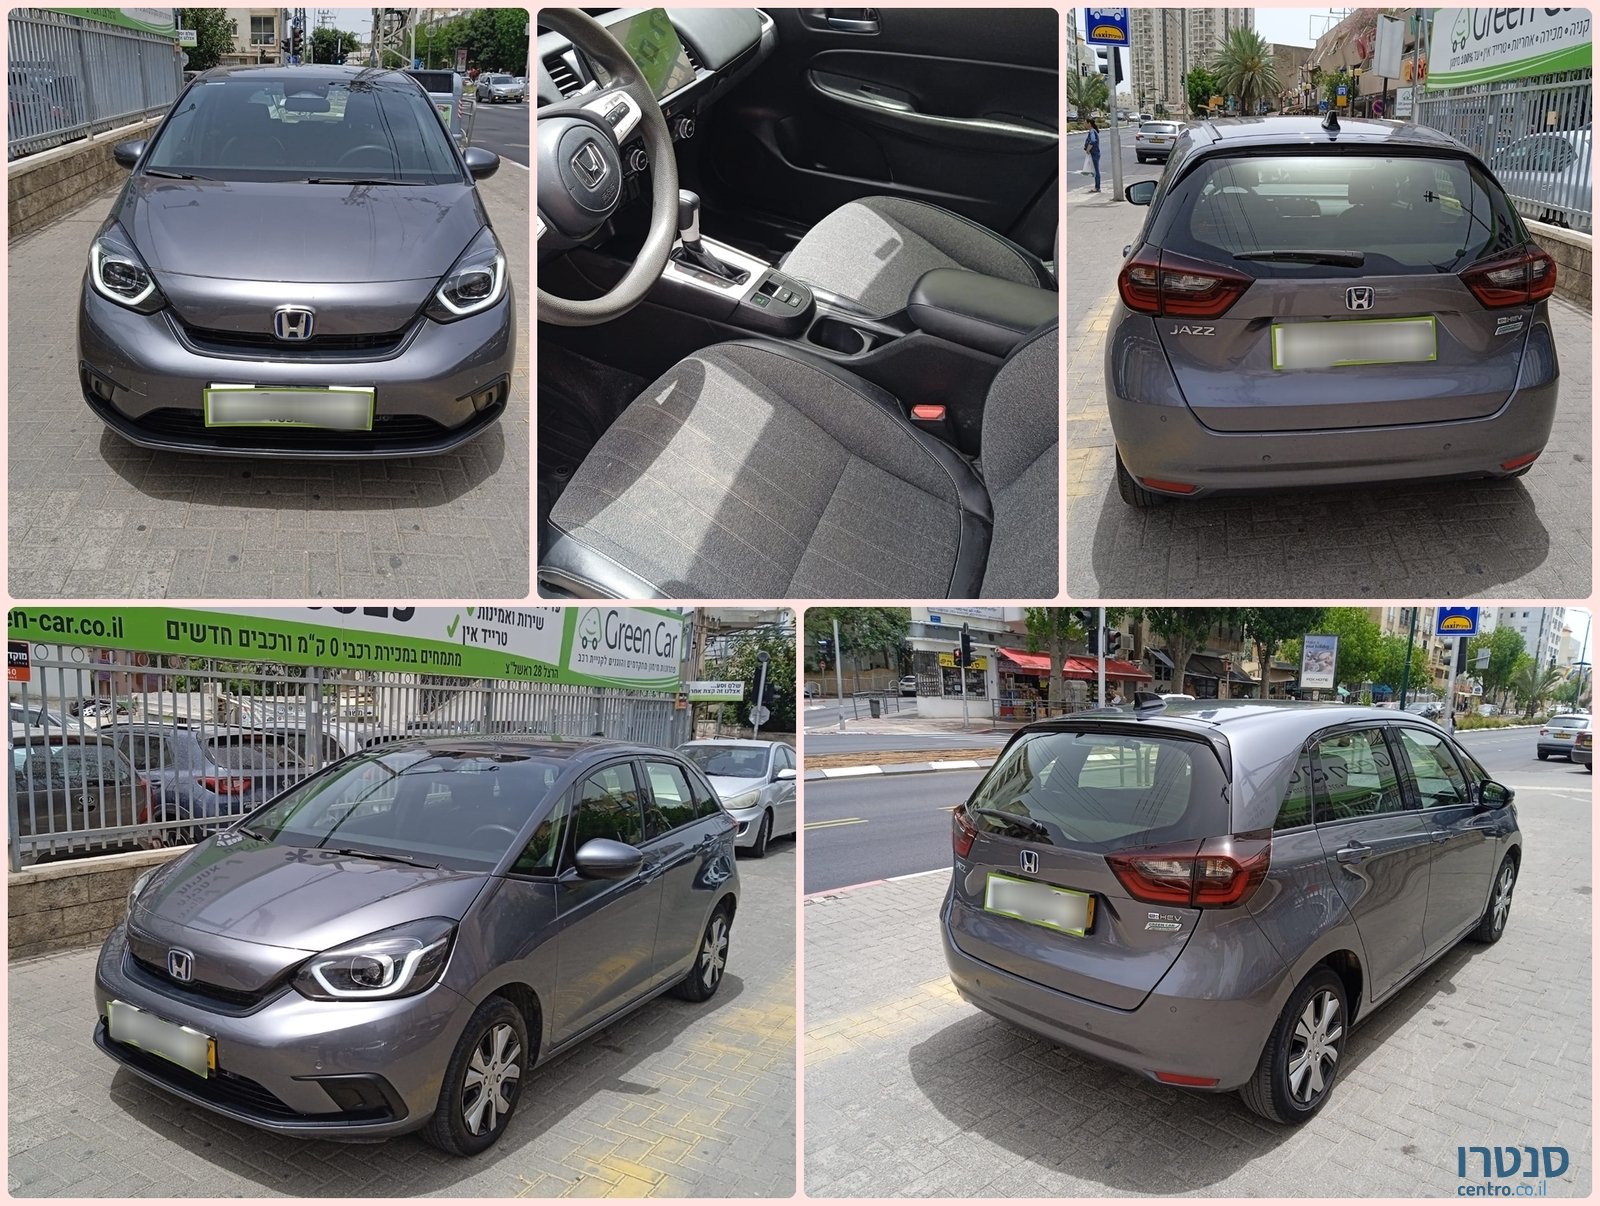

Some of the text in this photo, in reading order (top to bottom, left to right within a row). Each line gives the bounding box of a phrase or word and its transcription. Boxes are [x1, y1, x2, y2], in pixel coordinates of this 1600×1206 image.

[1540, 26, 1563, 44] מכירה
[1569, 19, 1591, 38] קניה
[1511, 34, 1535, 51] אחריות
[1460, 53, 1473, 65] 100%
[1169, 324, 1216, 336] JAZZ
[477, 607, 545, 631] שירות ואמינות
[166, 620, 232, 646] חדשים
[239, 629, 292, 652] ורכבים
[462, 625, 508, 646] טרייד אין
[605, 609, 678, 659] Green Car
[330, 637, 339, 657] 0
[342, 642, 371, 660] רכבי
[374, 645, 417, 663] במכירת
[420, 650, 462, 667] מתמחים
[577, 653, 588, 662] רכב
[589, 654, 607, 667] לקניית
[533, 665, 542, 676] 28
[543, 665, 559, 679] הרצל
